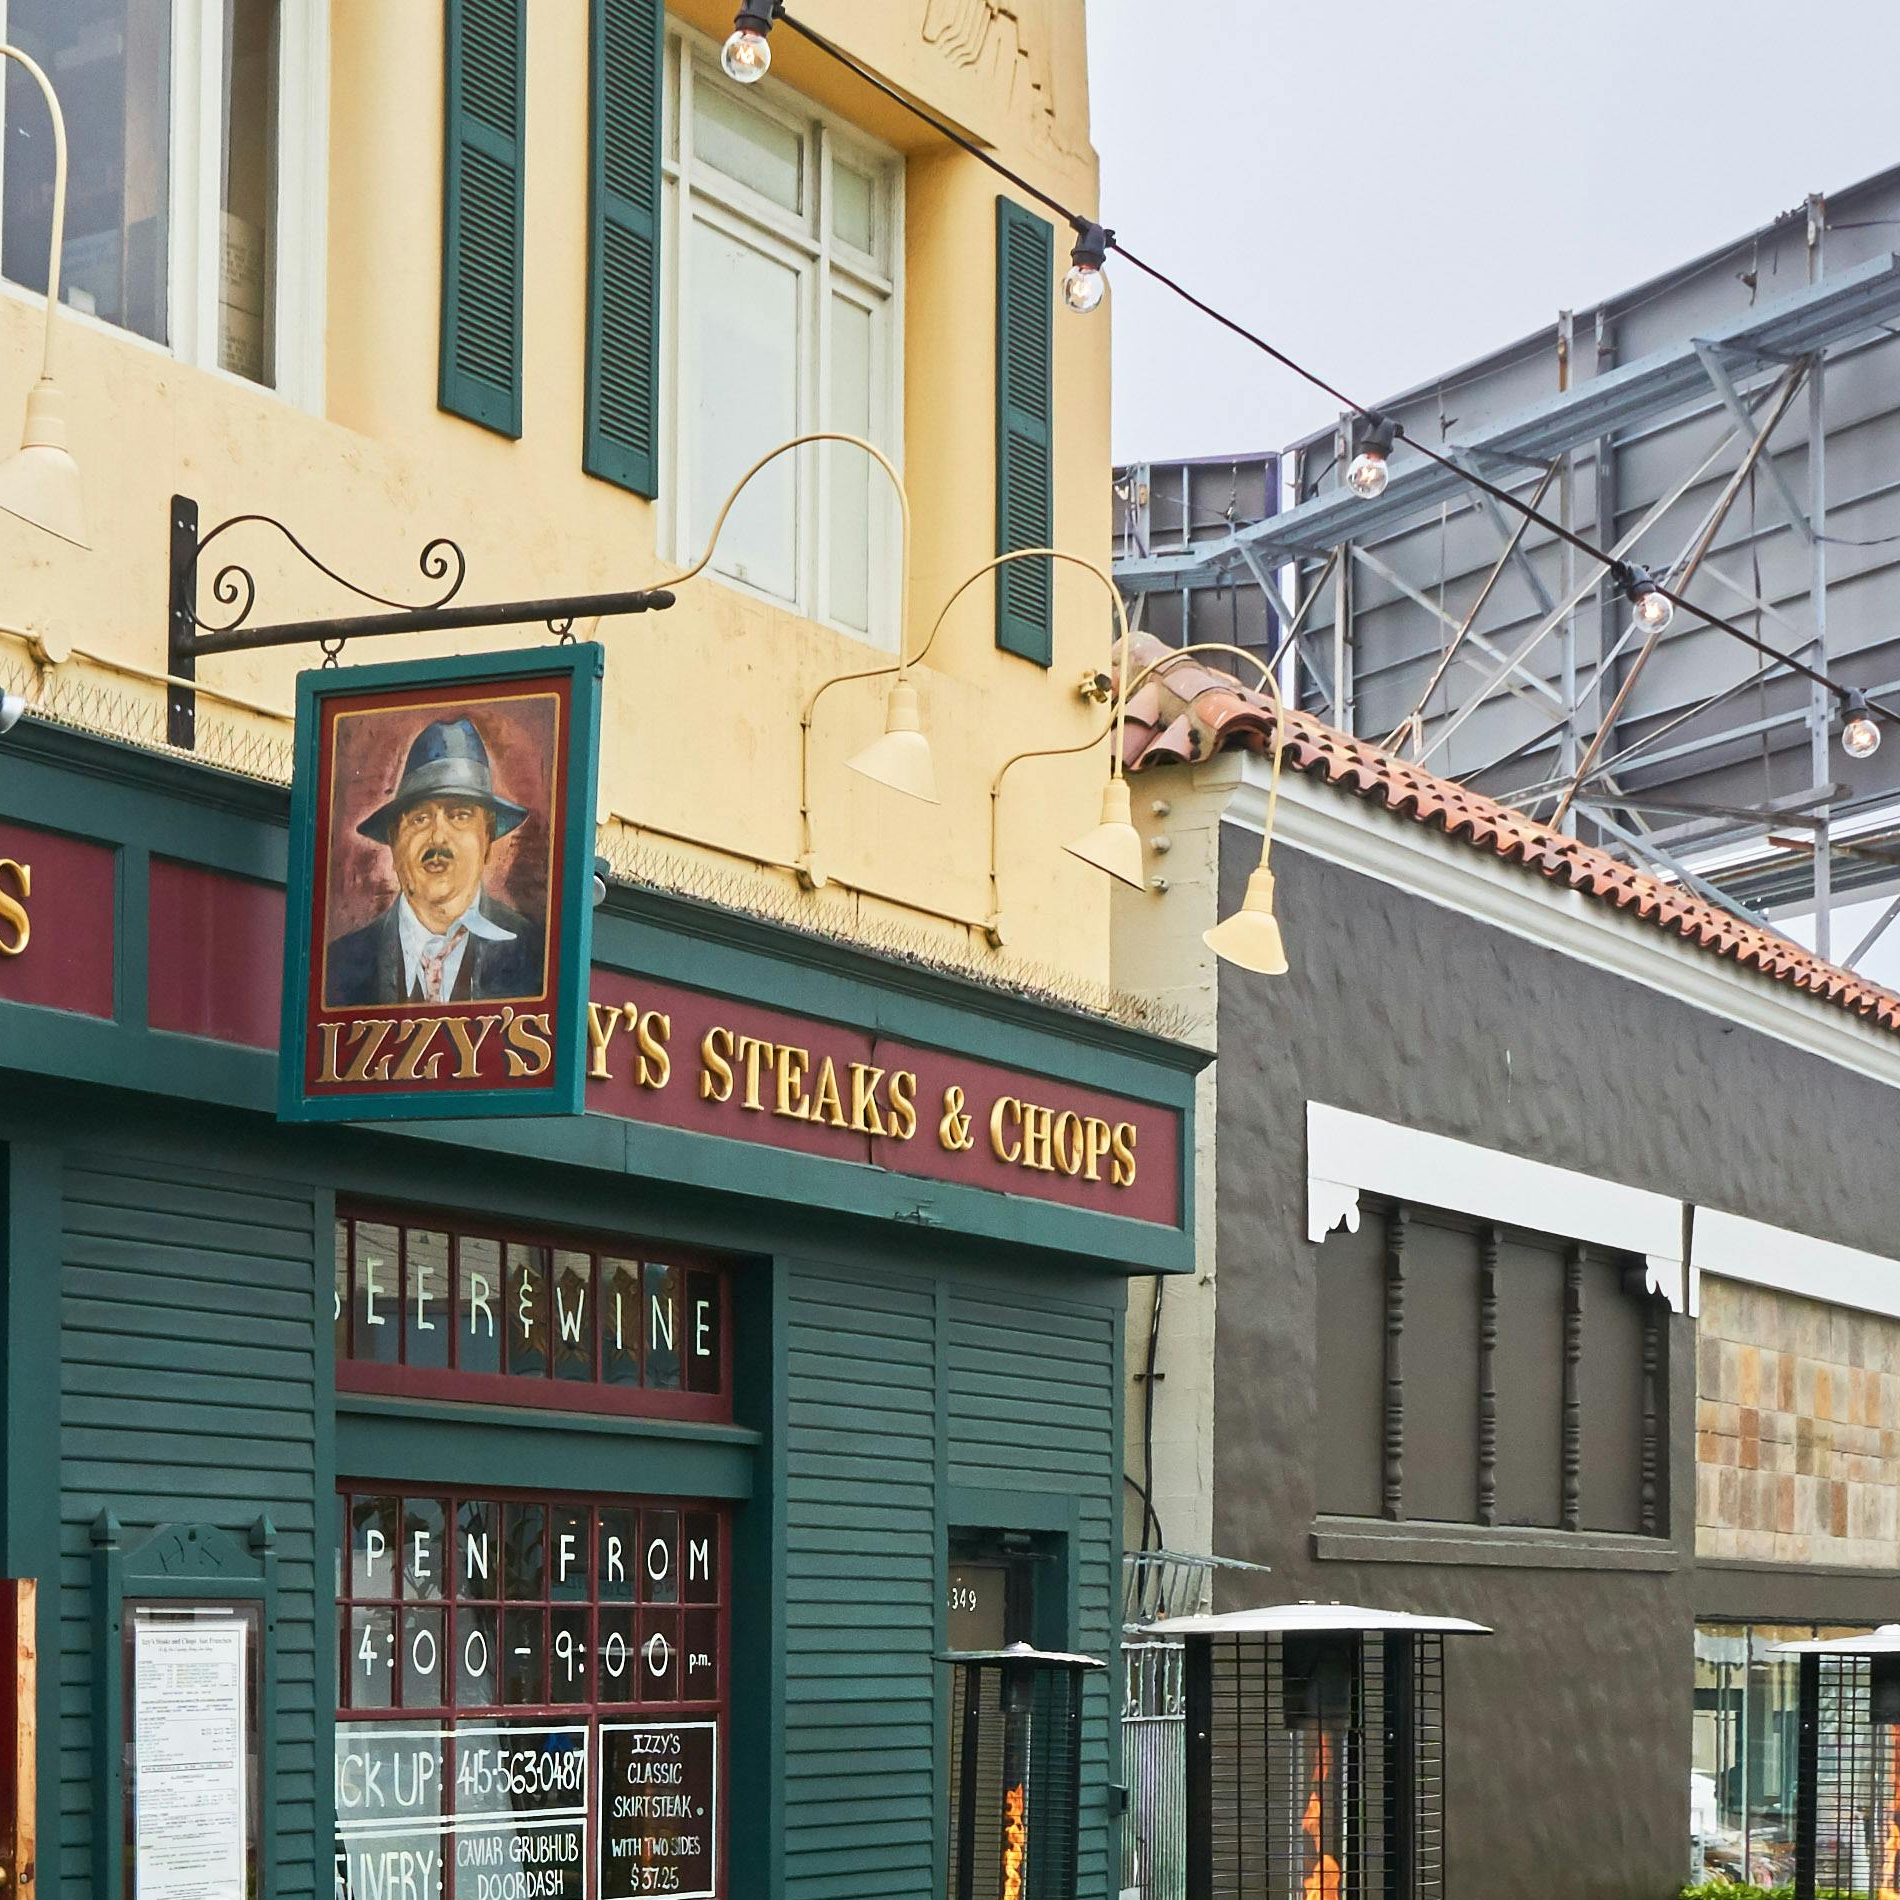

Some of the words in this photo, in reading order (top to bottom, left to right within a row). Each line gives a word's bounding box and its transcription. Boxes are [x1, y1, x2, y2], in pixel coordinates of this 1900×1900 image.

[316, 1005, 555, 1085] IZZY'S
[588, 1001, 672, 1091] Y'S
[700, 1026, 918, 1142] STEAKS
[940, 1086, 974, 1151] &
[988, 1097, 1138, 1189] CHOPS
[335, 1257, 493, 1338] EER
[519, 1269, 534, 1338] &
[556, 1286, 710, 1355] WINE
[366, 1529, 488, 1580] PEN
[560, 1534, 709, 1583] FROM
[947, 1587, 977, 1612] 349
[358, 1624, 488, 1677] 4:00
[555, 1630, 669, 1682] 9:00
[631, 1734, 681, 1755] IZZY'S
[335, 1751, 385, 1811] ICK
[394, 1750, 444, 1807] UP:
[627, 1762, 683, 1785] CLASSIC
[613, 1796, 652, 1818] SKIRT
[652, 1796, 692, 1818] STEAK
[456, 1836, 502, 1867] CAVIAR
[510, 1832, 579, 1864] GRUBHUB
[611, 1837, 642, 1857] WITH
[643, 1836, 669, 1856] TWO
